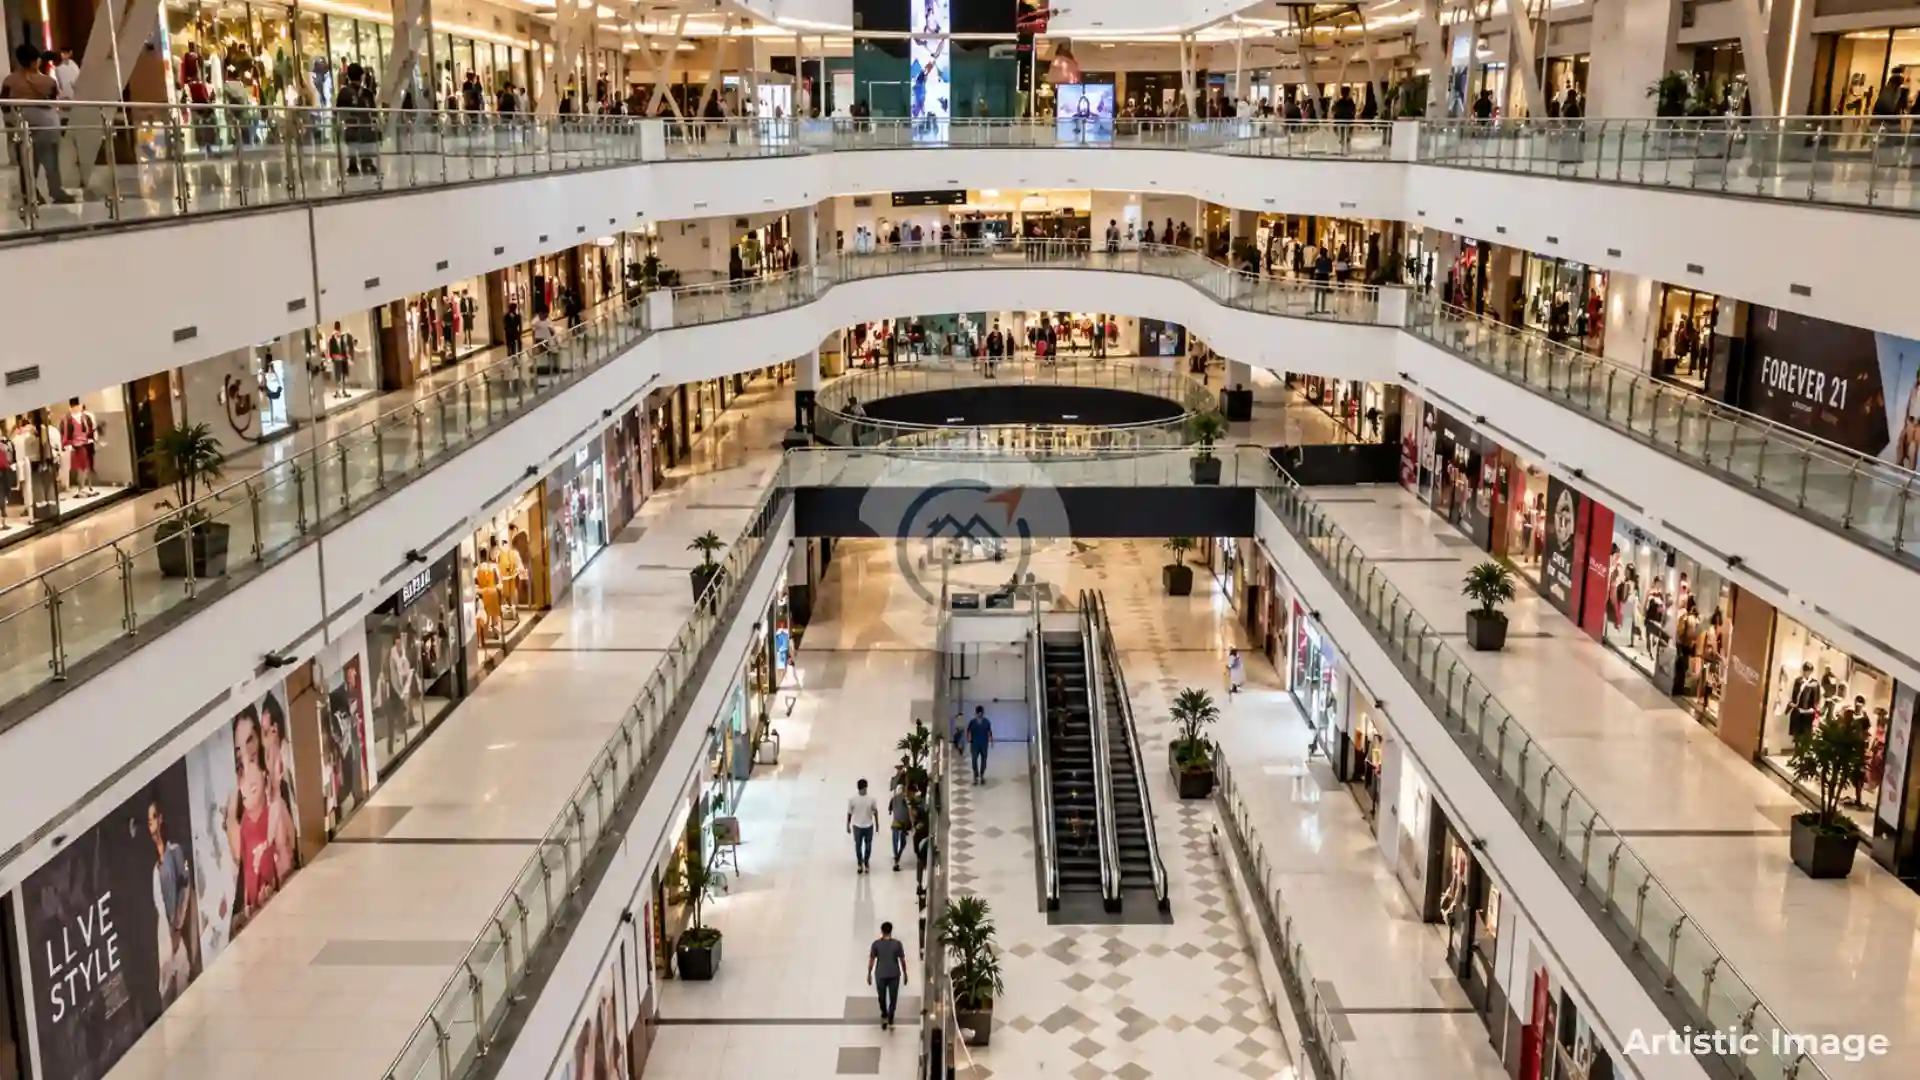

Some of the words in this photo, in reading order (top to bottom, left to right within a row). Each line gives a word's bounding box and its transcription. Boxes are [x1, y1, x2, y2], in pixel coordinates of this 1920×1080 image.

[1761, 356, 1825, 402] FOREVER
[1829, 376, 1847, 410] 21
[51, 932, 120, 1023] STYLE
